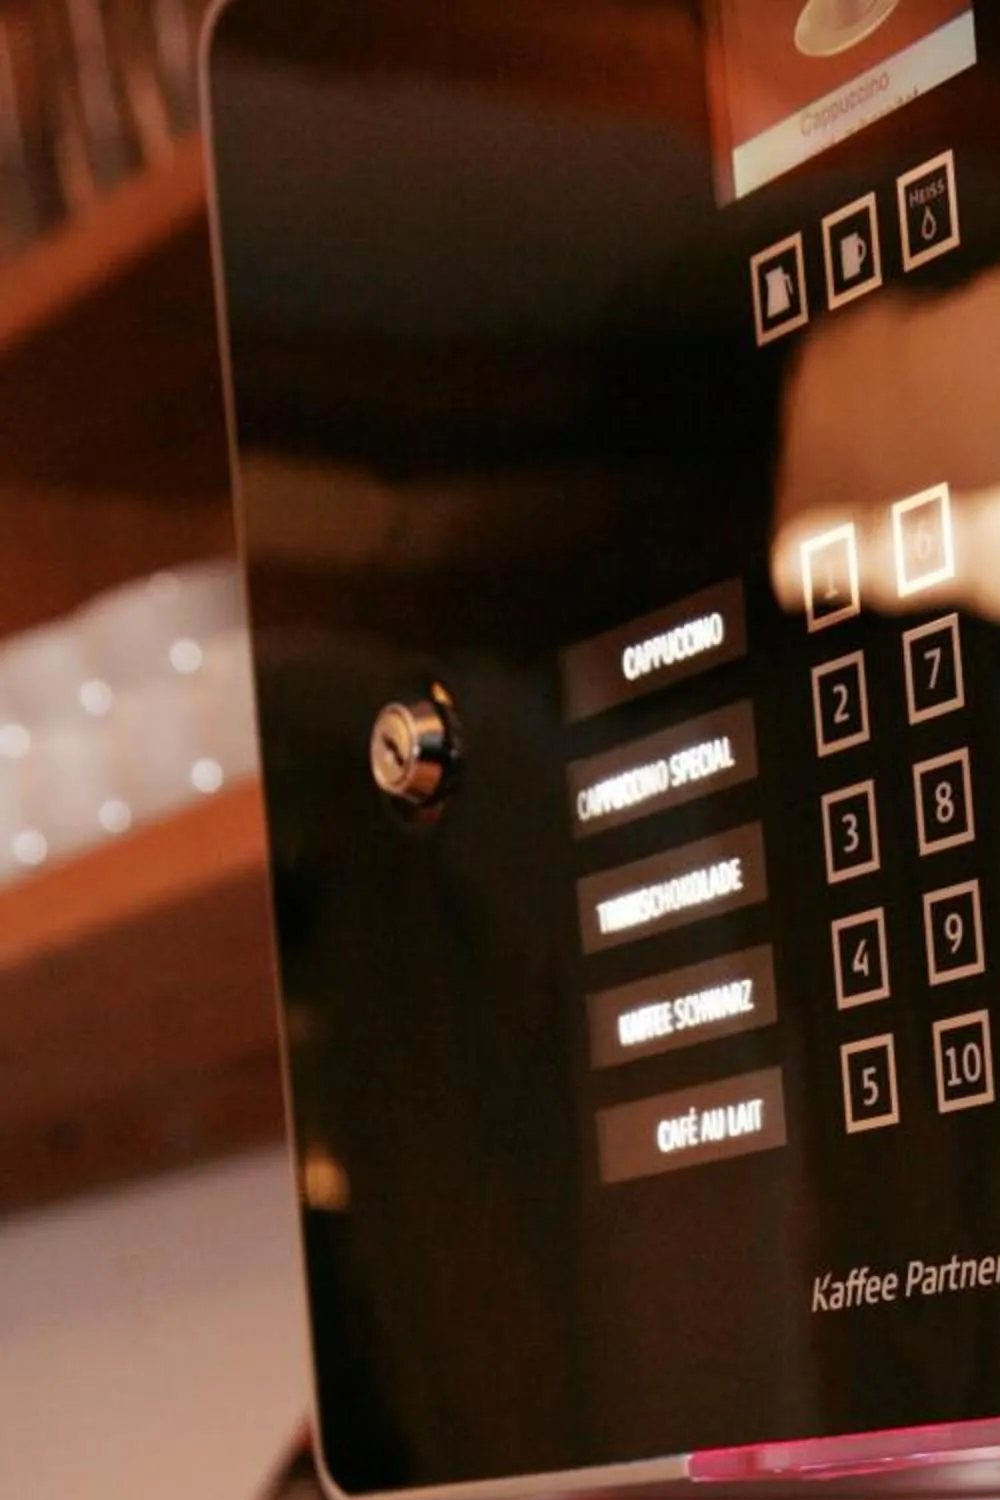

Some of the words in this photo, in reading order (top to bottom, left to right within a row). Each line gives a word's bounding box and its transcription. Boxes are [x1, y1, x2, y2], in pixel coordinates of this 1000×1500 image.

[800, 72, 890, 136] Cappuccino
[622, 612, 725, 681] CAPPUCCINO
[924, 647, 941, 689] 7
[832, 683, 850, 724] 2
[668, 735, 736, 788] SPECIAL
[935, 781, 955, 823] 8
[842, 813, 859, 853] 3
[595, 857, 744, 935] TSCHOKOLADE
[944, 913, 963, 953] 9
[852, 939, 869, 977] 4
[617, 1001, 676, 1047] KAFFEE
[673, 978, 756, 1031] SCHWARZ
[862, 1066, 879, 1106] 5
[944, 1042, 982, 1087] 10
[657, 1105, 699, 1153] CAFÉ
[700, 1107, 726, 1144] AU
[726, 1098, 765, 1138] LAIT
[811, 1265, 899, 1312] Kaffee
